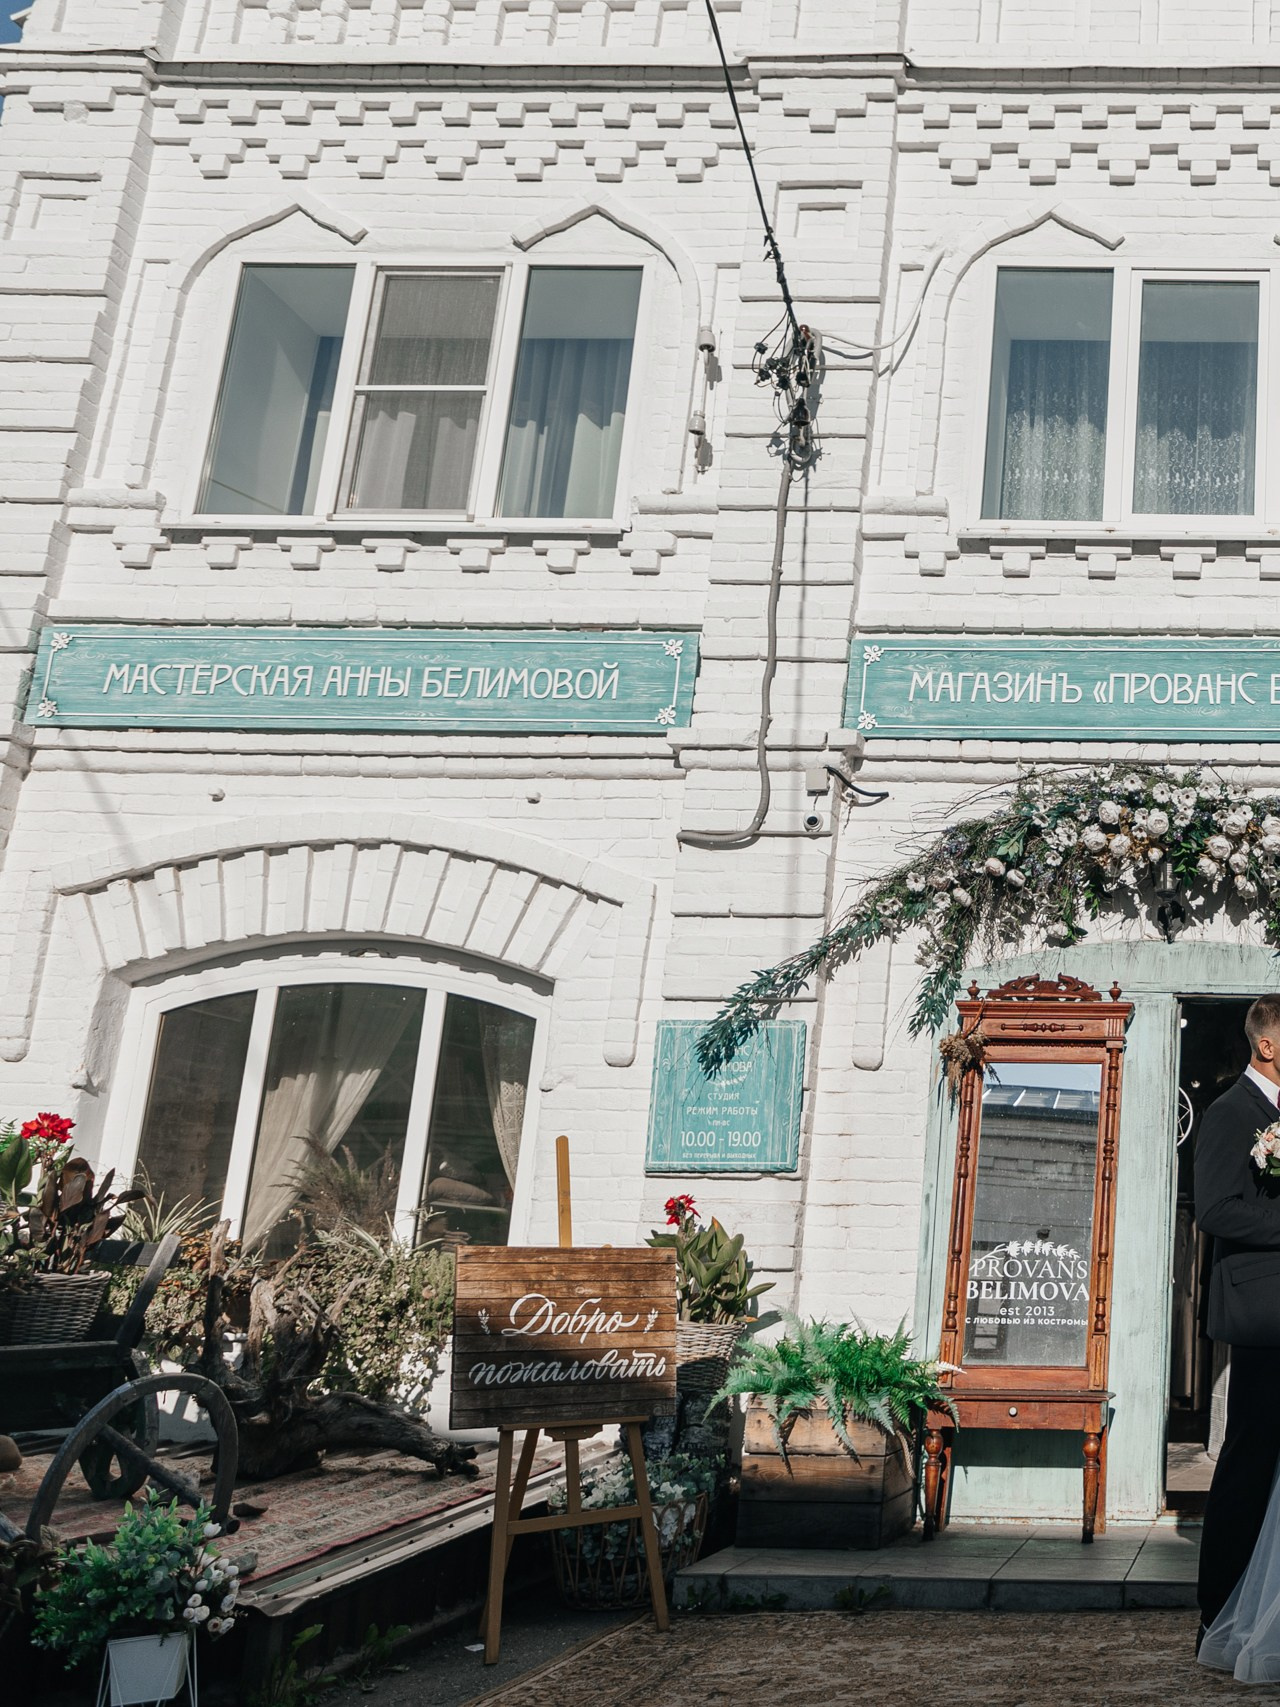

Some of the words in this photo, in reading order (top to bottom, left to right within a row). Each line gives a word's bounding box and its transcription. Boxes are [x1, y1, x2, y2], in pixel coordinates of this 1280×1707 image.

[102, 663, 314, 697] МАСТЕРСКАЯ
[321, 665, 412, 697] АННЫ
[421, 661, 620, 700] БЕЛИМОВОЙ
[908, 671, 1083, 704] МАГАЗИНЪ
[1093, 672, 1258, 705] «ПРОВАНС
[707, 1092, 740, 1101] СТУДИЯ
[686, 1106, 719, 1115] РЕЖИМ
[721, 1106, 758, 1115] РАБОТЫ
[681, 1130, 716, 1147] 10.00
[728, 1131, 761, 1147] 19.00
[971, 1258, 1088, 1279] PROVANS
[966, 1280, 1090, 1301] BELIMOVA
[501, 1293, 640, 1344] Добро
[973, 1317, 1021, 1325] ЛЮБОВЬЮ
[1038, 1318, 1089, 1326] КОСТРОМЫ
[999, 1307, 1020, 1316] est
[1025, 1306, 1055, 1316] 2013
[468, 1349, 666, 1385] пожаловать
